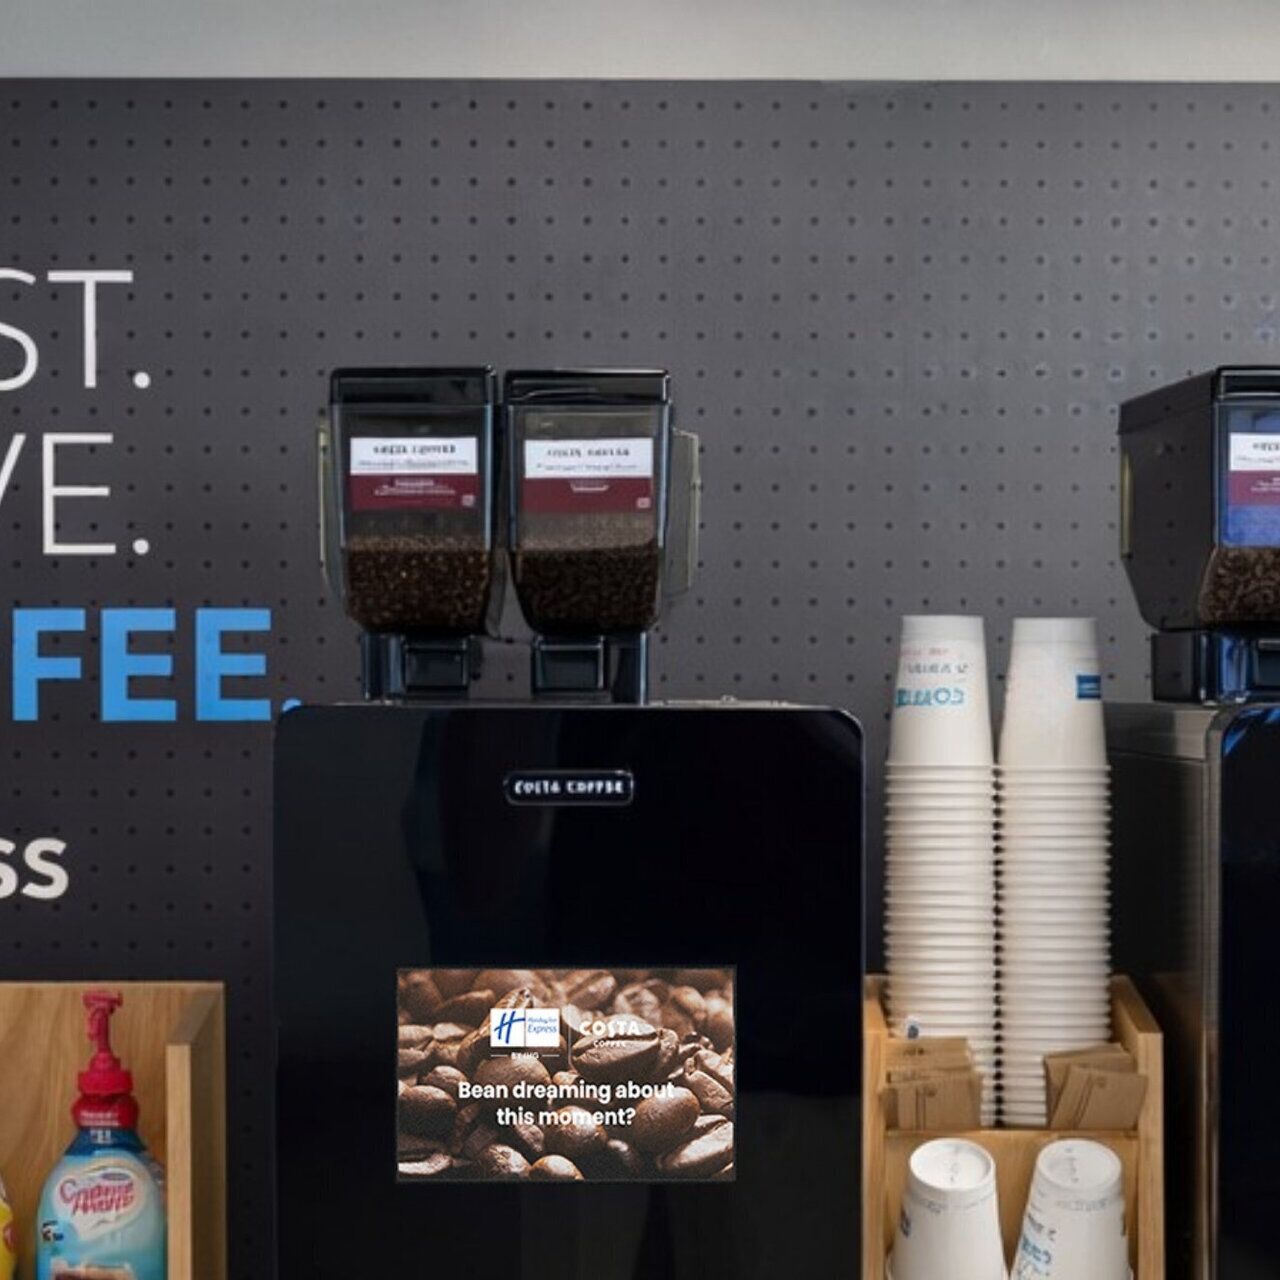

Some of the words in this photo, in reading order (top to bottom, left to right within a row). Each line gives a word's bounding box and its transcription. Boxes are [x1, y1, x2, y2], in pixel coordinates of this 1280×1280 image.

[528, 1025, 557, 1034] Express
[580, 1021, 639, 1038] COSTA
[458, 1082, 508, 1098] Bean
[513, 1080, 611, 1104] dreaming
[615, 1081, 675, 1098] about
[497, 1107, 534, 1125] this
[539, 1108, 636, 1125] moment?
